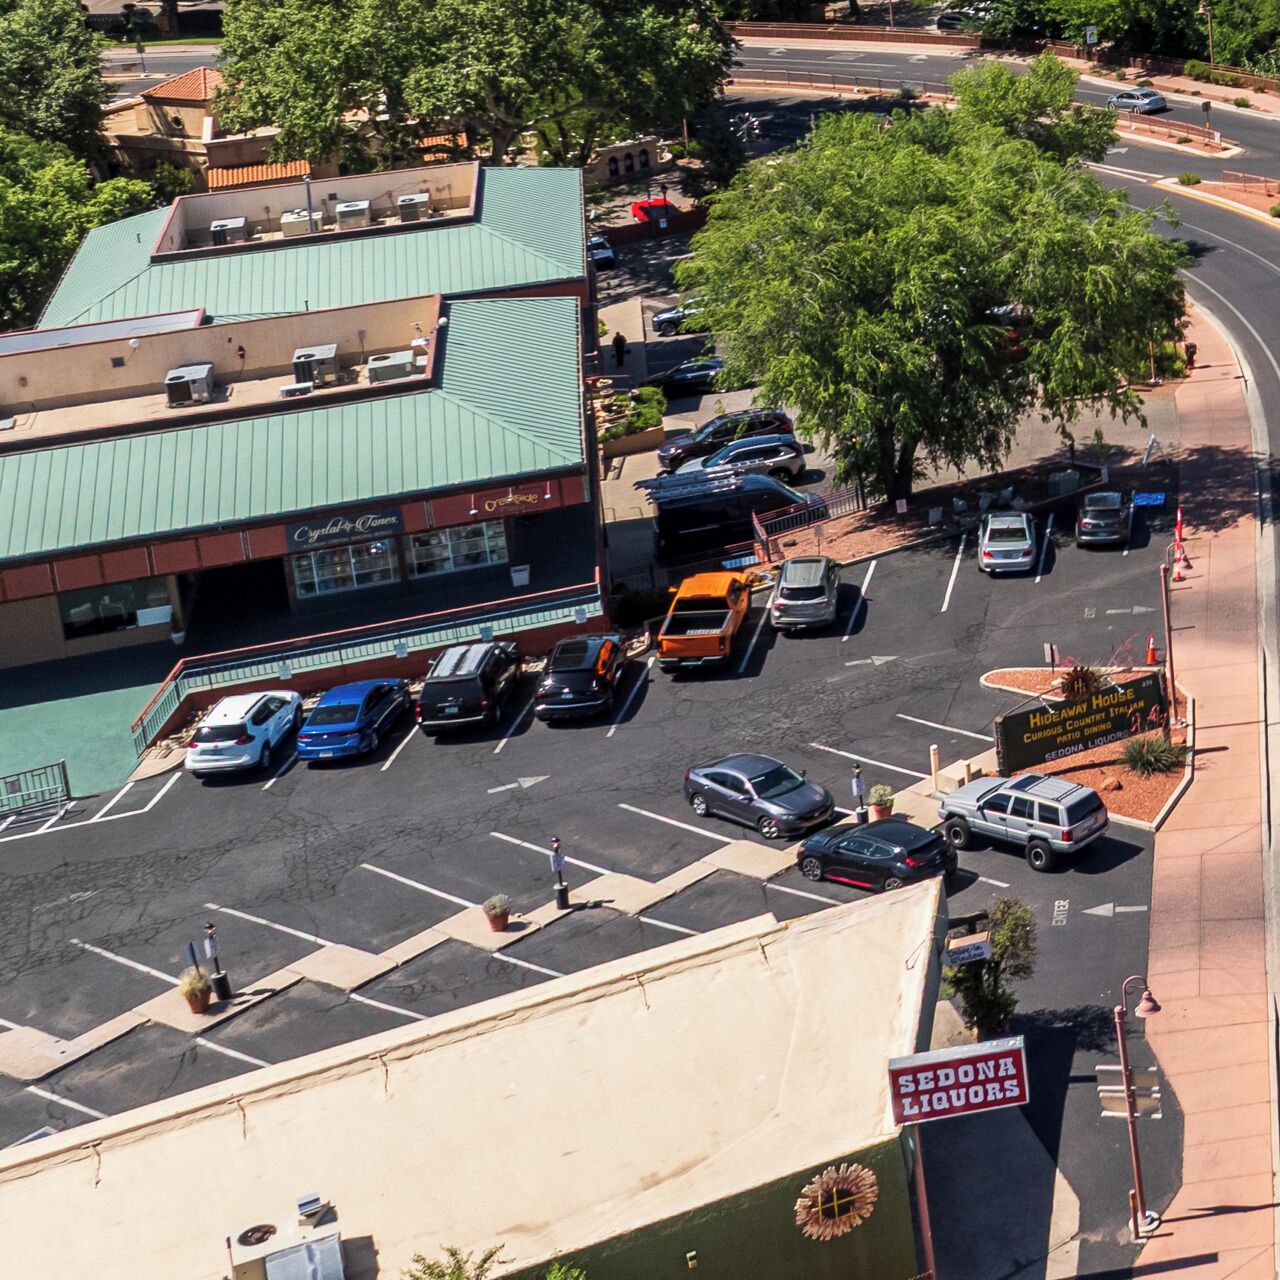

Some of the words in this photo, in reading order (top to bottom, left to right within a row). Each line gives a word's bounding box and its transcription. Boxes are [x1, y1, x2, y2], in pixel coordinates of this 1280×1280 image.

[294, 516, 345, 543] Crystal
[355, 514, 397, 533] Tones
[1029, 701, 1088, 729] HIDEAWAY
[1092, 688, 1135, 708] HOUSE
[1023, 724, 1063, 744] CURIOUS
[1066, 712, 1106, 730] COUNTRY
[1056, 732, 1081, 745] PATIO
[1084, 721, 1112, 735] DINING
[1044, 742, 1084, 762] SEDONA
[1088, 729, 1130, 748] LIQUORS
[1052, 899, 1070, 926] ENTER
[899, 1057, 1017, 1094] SEDONA
[902, 1079, 1020, 1116] LIQUORS
